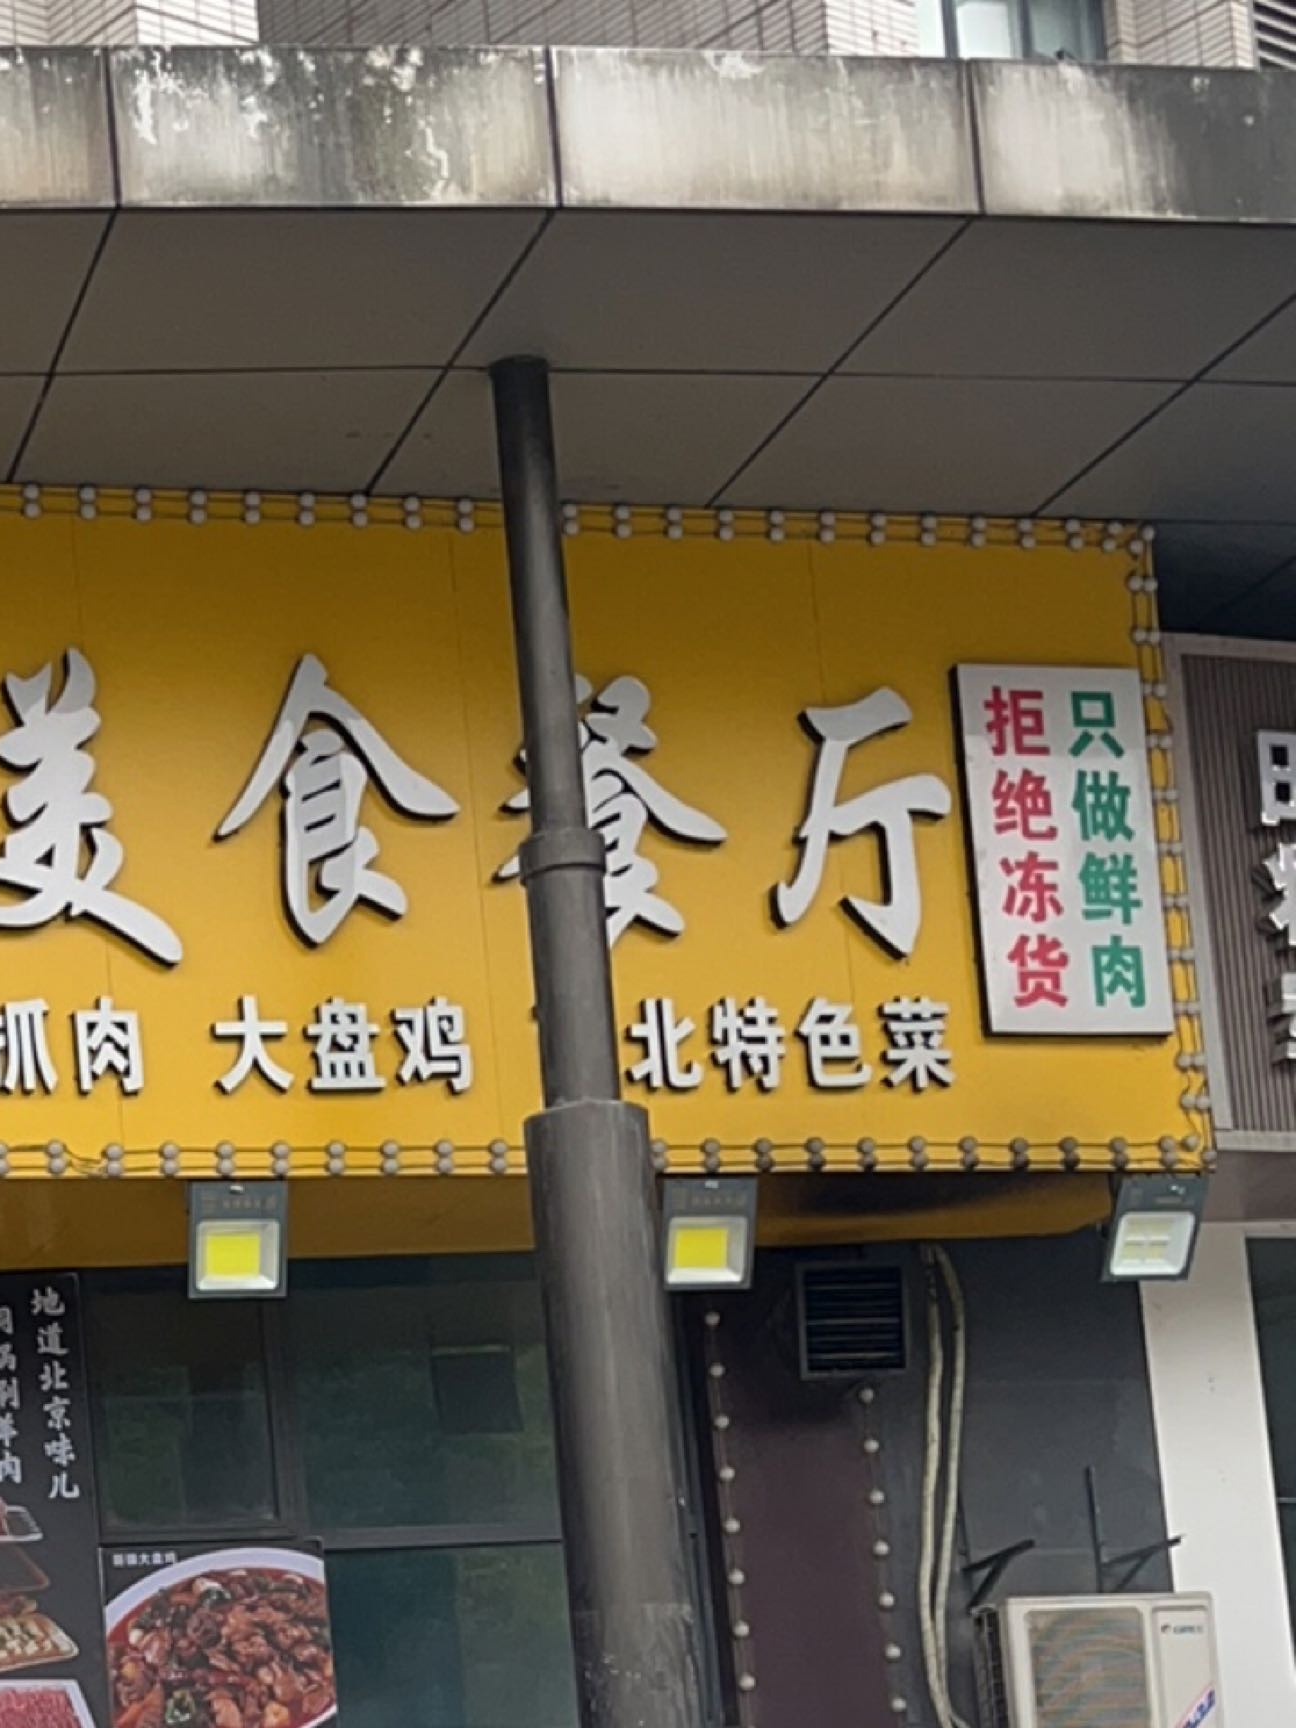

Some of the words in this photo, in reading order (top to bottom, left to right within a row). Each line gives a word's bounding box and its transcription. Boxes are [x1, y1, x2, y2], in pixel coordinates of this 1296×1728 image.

[985, 685, 1070, 1008] 拒绝冻货
[1069, 690, 1146, 1008] 只做鲜肉
[211, 996, 474, 1096] 大盘鸡
[532, 996, 957, 1094] 北特色菜
[30, 1286, 80, 1501] 地道北京味儿
